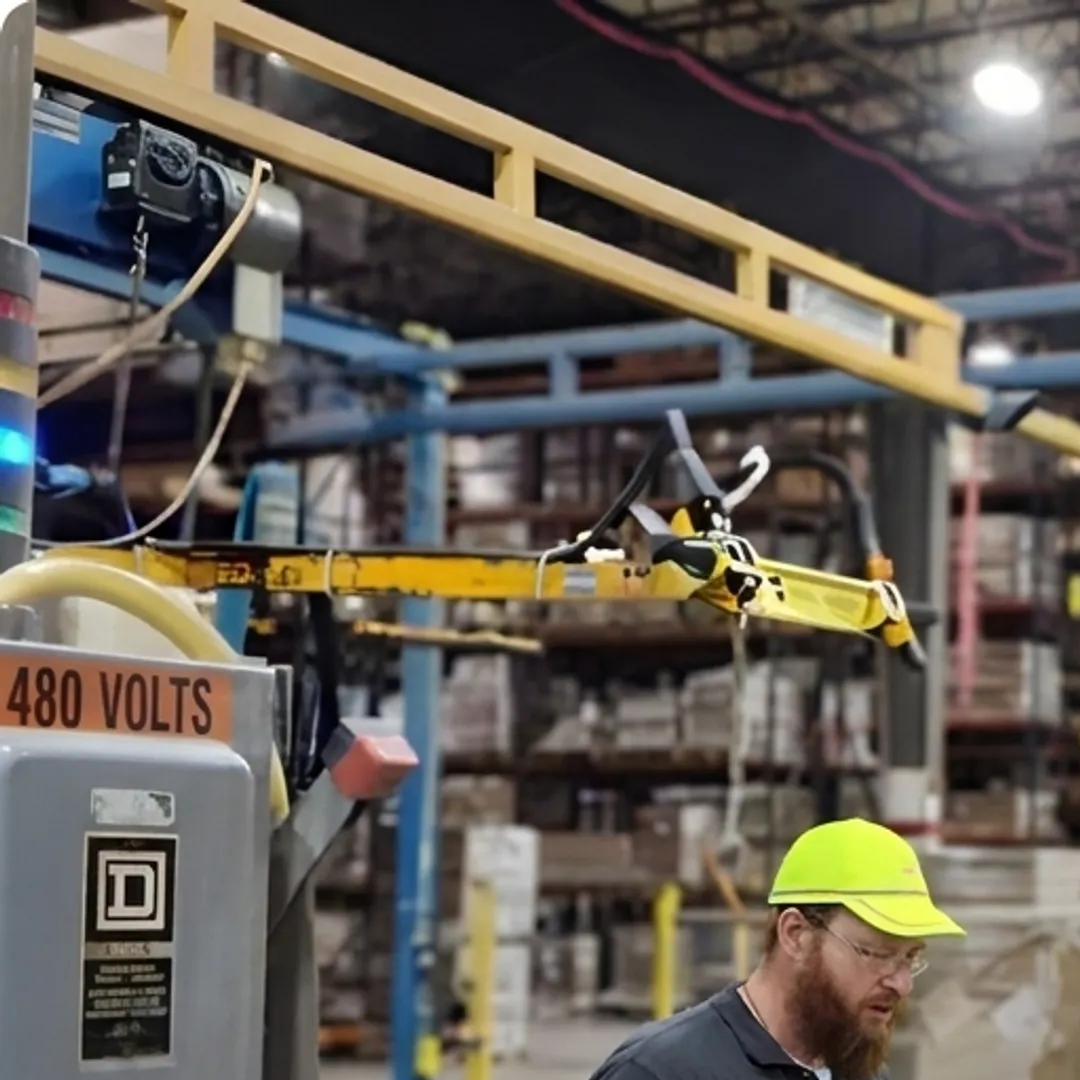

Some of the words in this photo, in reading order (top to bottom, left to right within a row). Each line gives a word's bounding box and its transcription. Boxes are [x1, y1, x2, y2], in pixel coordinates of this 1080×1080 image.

[6, 666, 82, 728] 480
[99, 671, 212, 735] VOLTS
[107, 864, 155, 917] D
